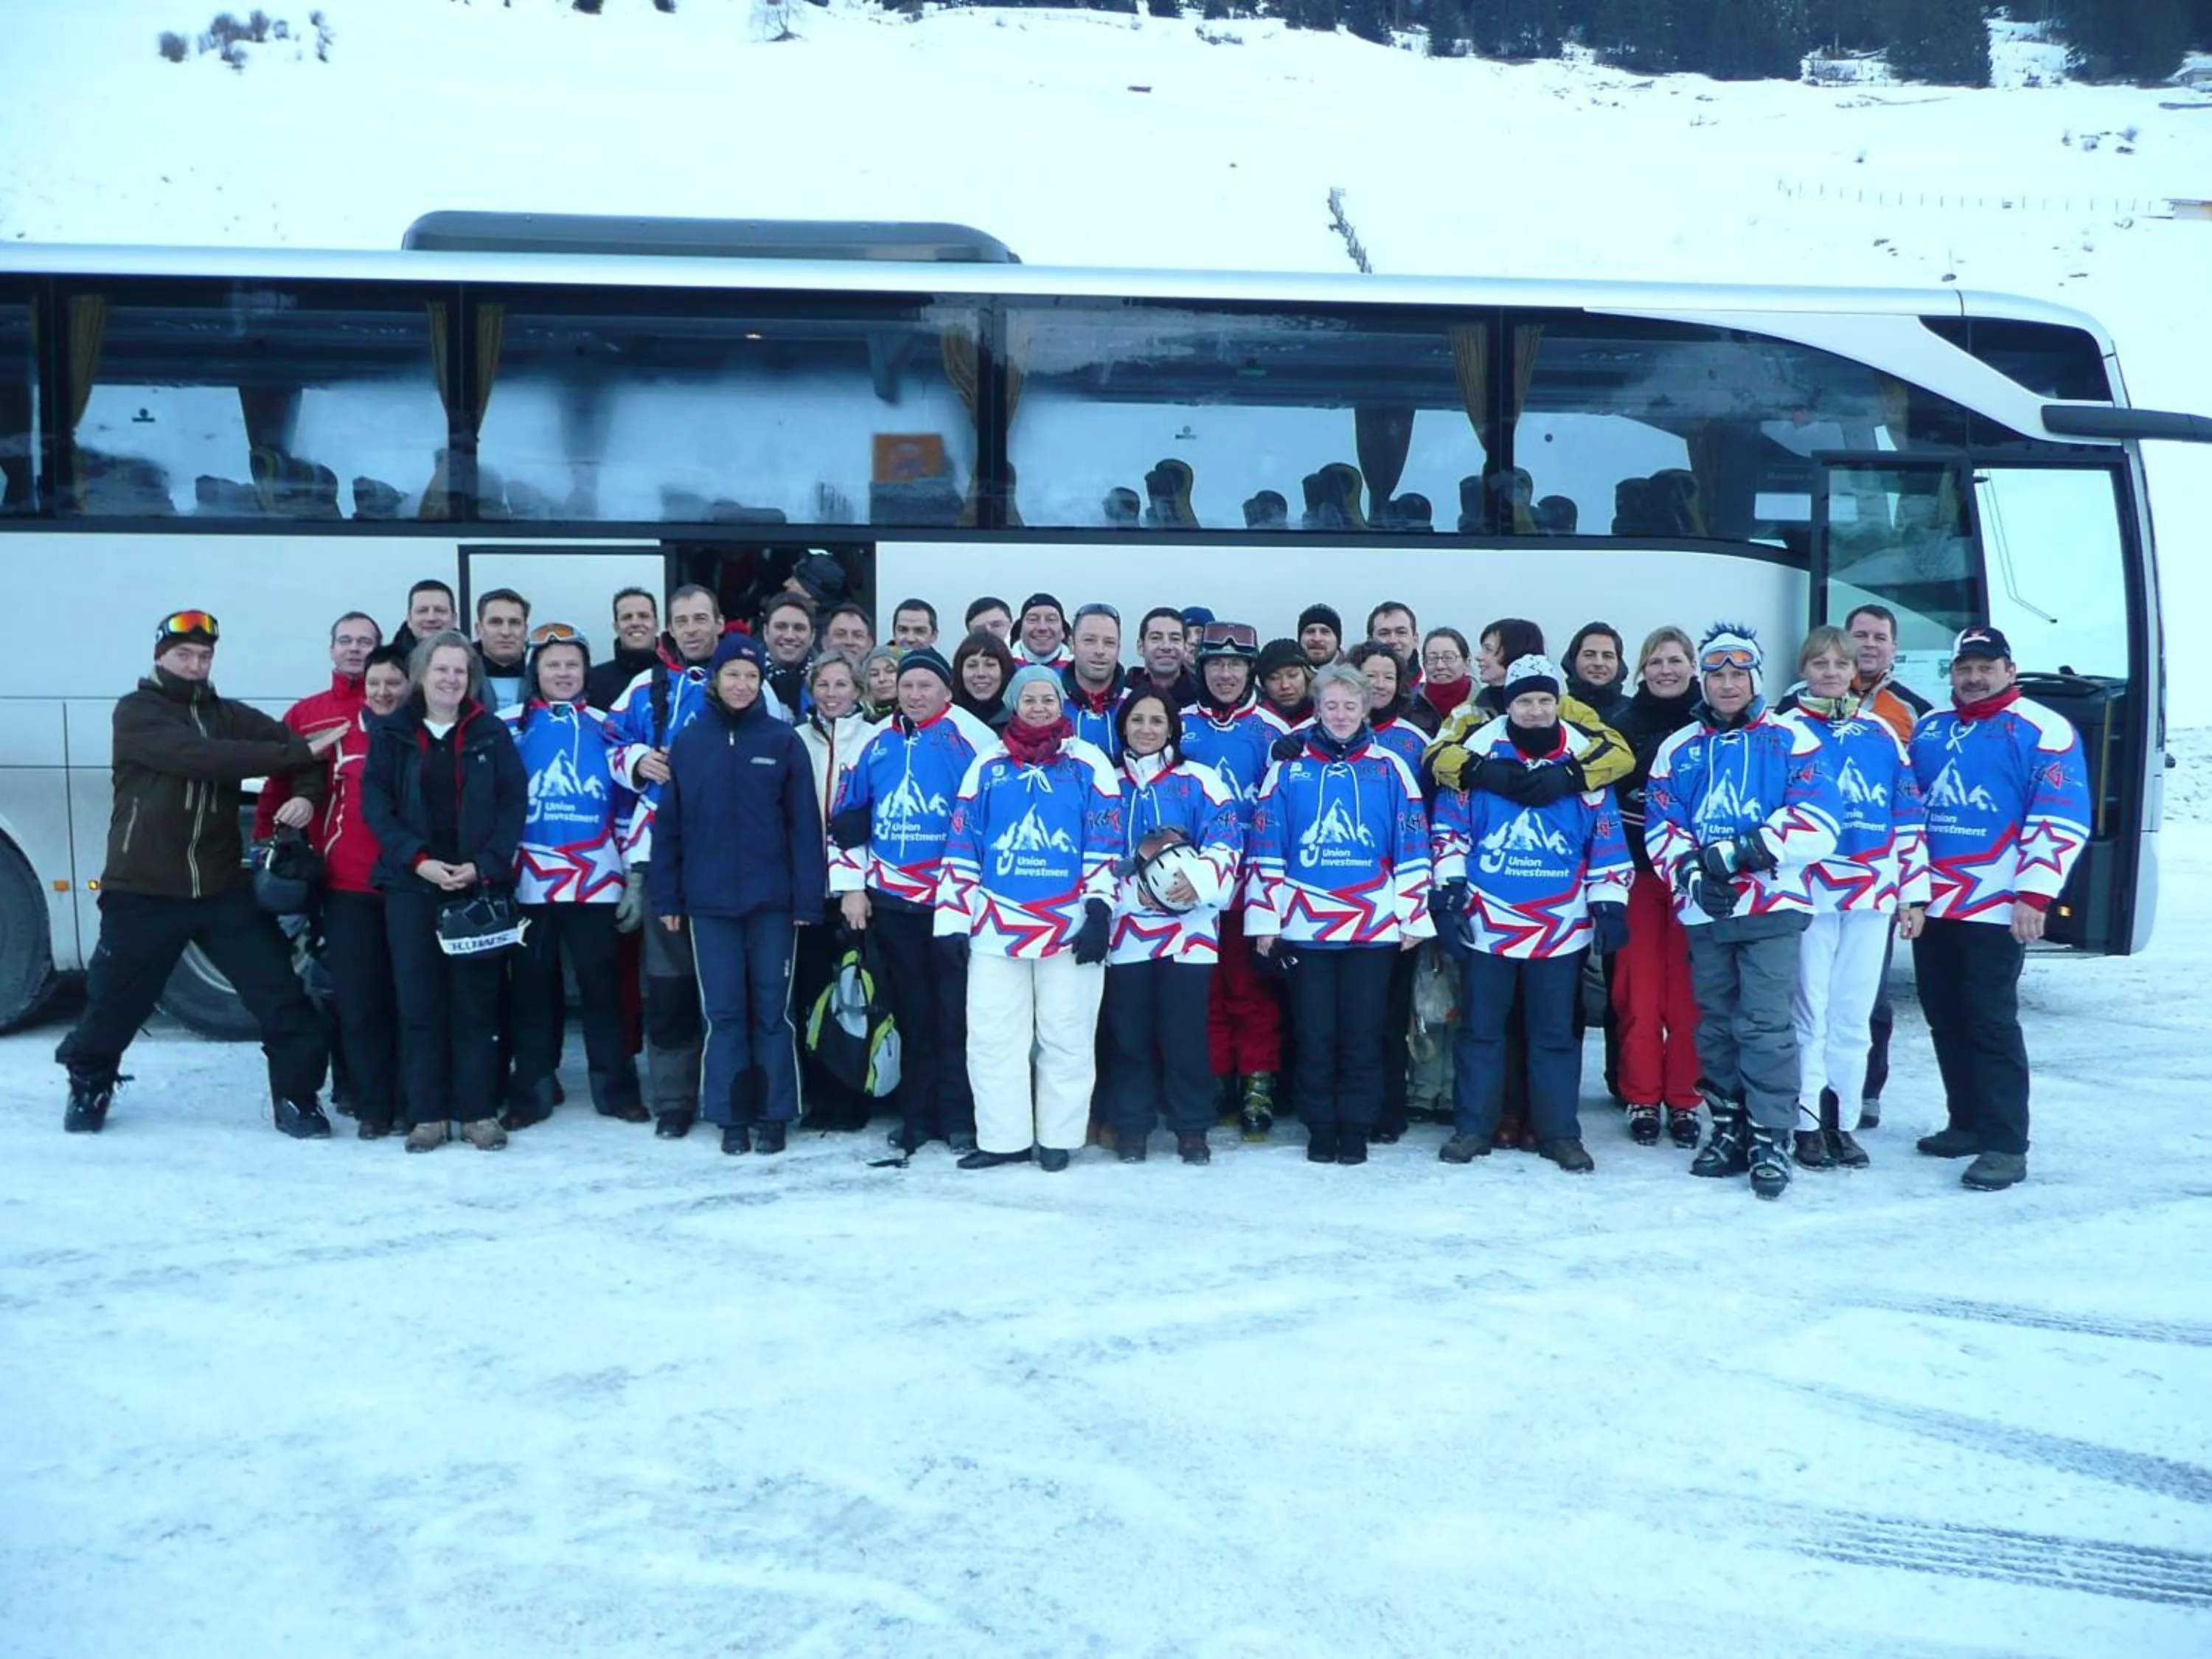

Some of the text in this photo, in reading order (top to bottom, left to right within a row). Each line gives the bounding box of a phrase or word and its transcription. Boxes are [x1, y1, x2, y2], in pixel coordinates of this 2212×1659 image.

[545, 801, 576, 812] Union
[1708, 824, 1735, 834] Unon
[1323, 847, 1352, 858] Union
[1017, 855, 1047, 866] Union
[1321, 858, 1373, 868] Investment
[1508, 855, 1543, 867] Union
[1504, 866, 1571, 879] Investment
